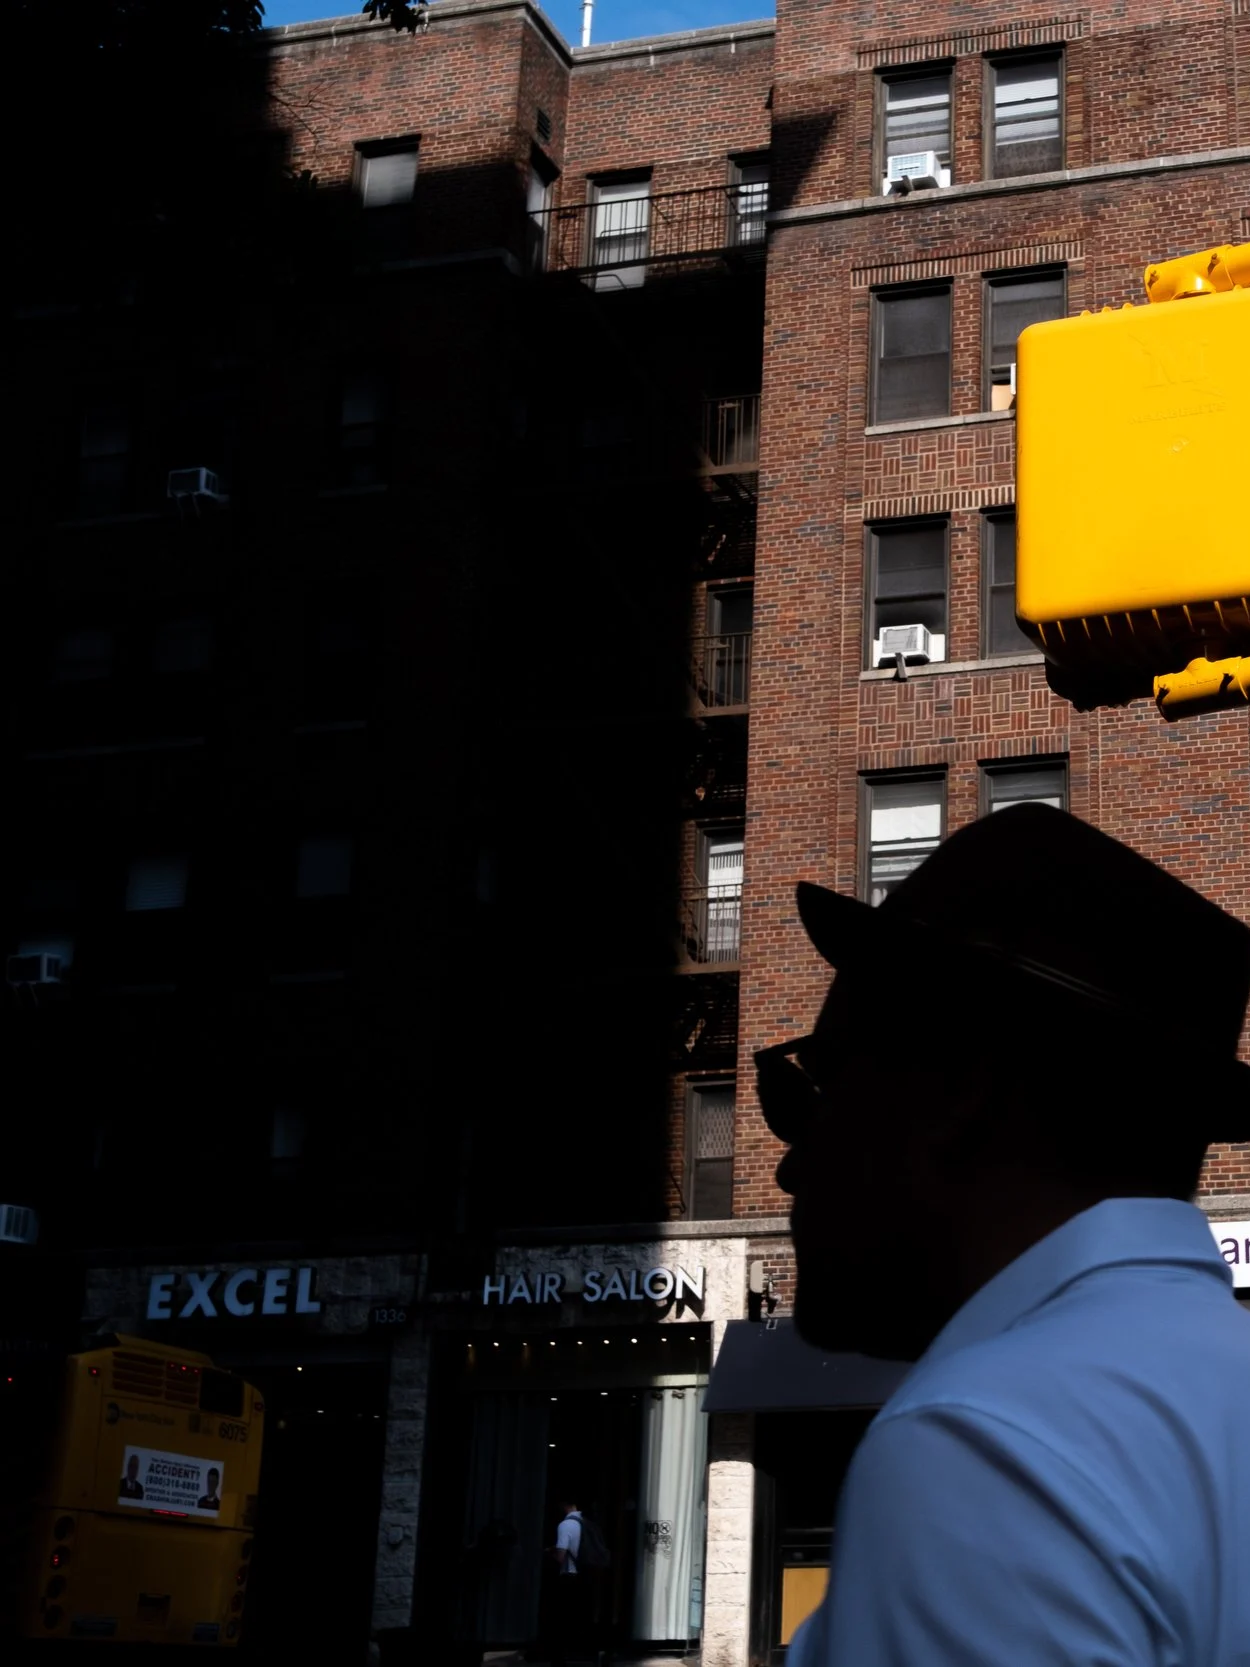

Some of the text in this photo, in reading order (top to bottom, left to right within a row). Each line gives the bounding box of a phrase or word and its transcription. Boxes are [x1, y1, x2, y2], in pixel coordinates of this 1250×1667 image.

[147, 1268, 320, 1319] EXCEL
[482, 1266, 705, 1306] HAIR SALON
[374, 1308, 407, 1325] 1336
[219, 1422, 247, 1443] 6075
[148, 1463, 200, 1481] ACCIDENT?
